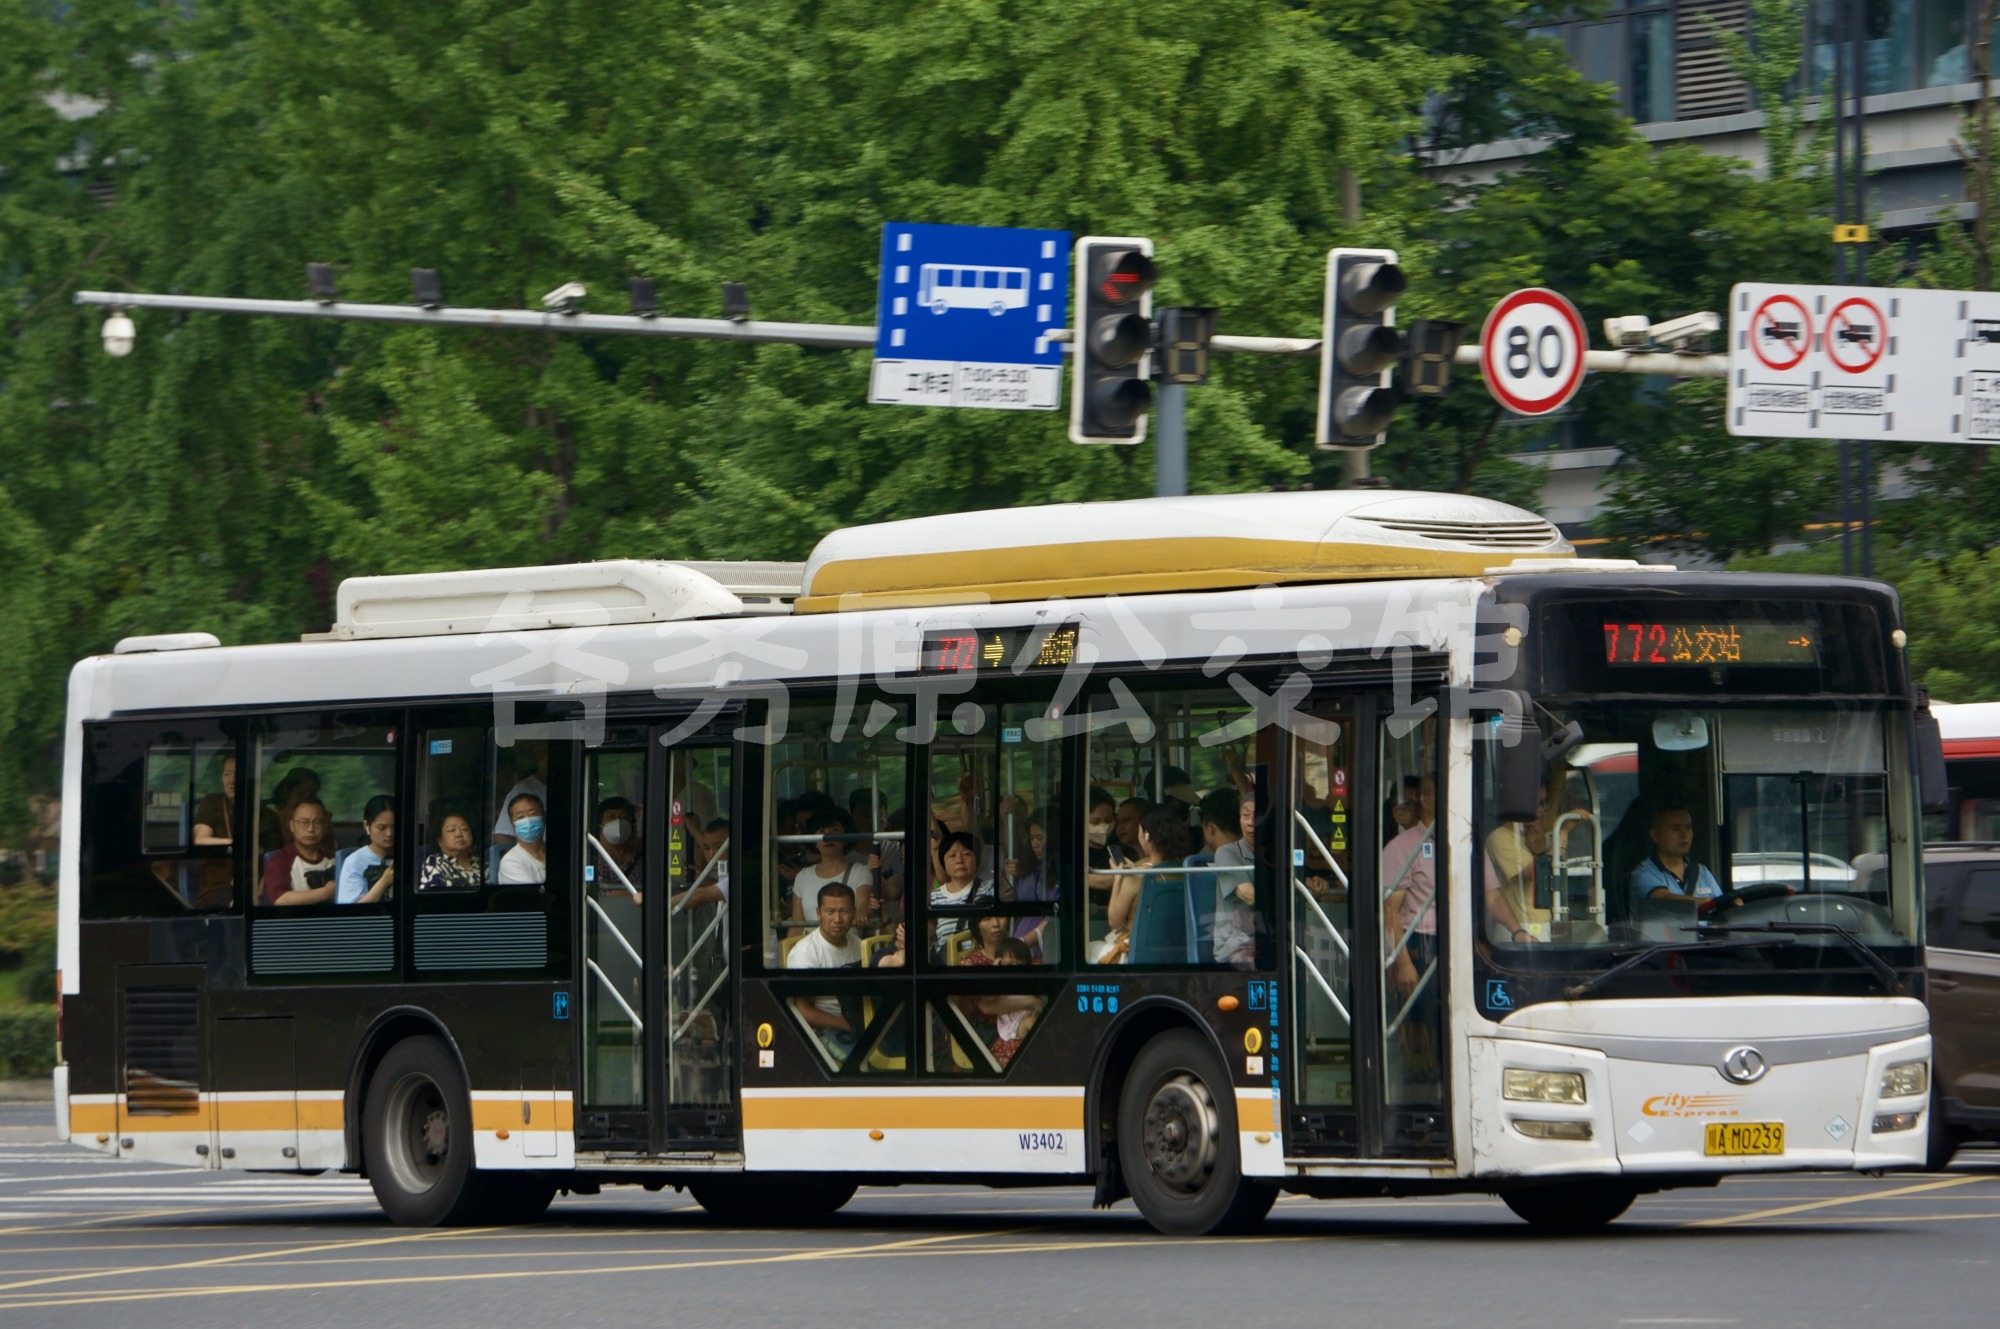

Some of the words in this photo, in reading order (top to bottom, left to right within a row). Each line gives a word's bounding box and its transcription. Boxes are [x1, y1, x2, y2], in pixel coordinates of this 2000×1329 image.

[1507, 324, 1563, 379] 80
[938, 637, 976, 671] 772
[1603, 624, 1667, 662] 772
[1671, 625, 1741, 663] 公交站
[1641, 1092, 1692, 1117] City
[1019, 1132, 1064, 1150] W3402
